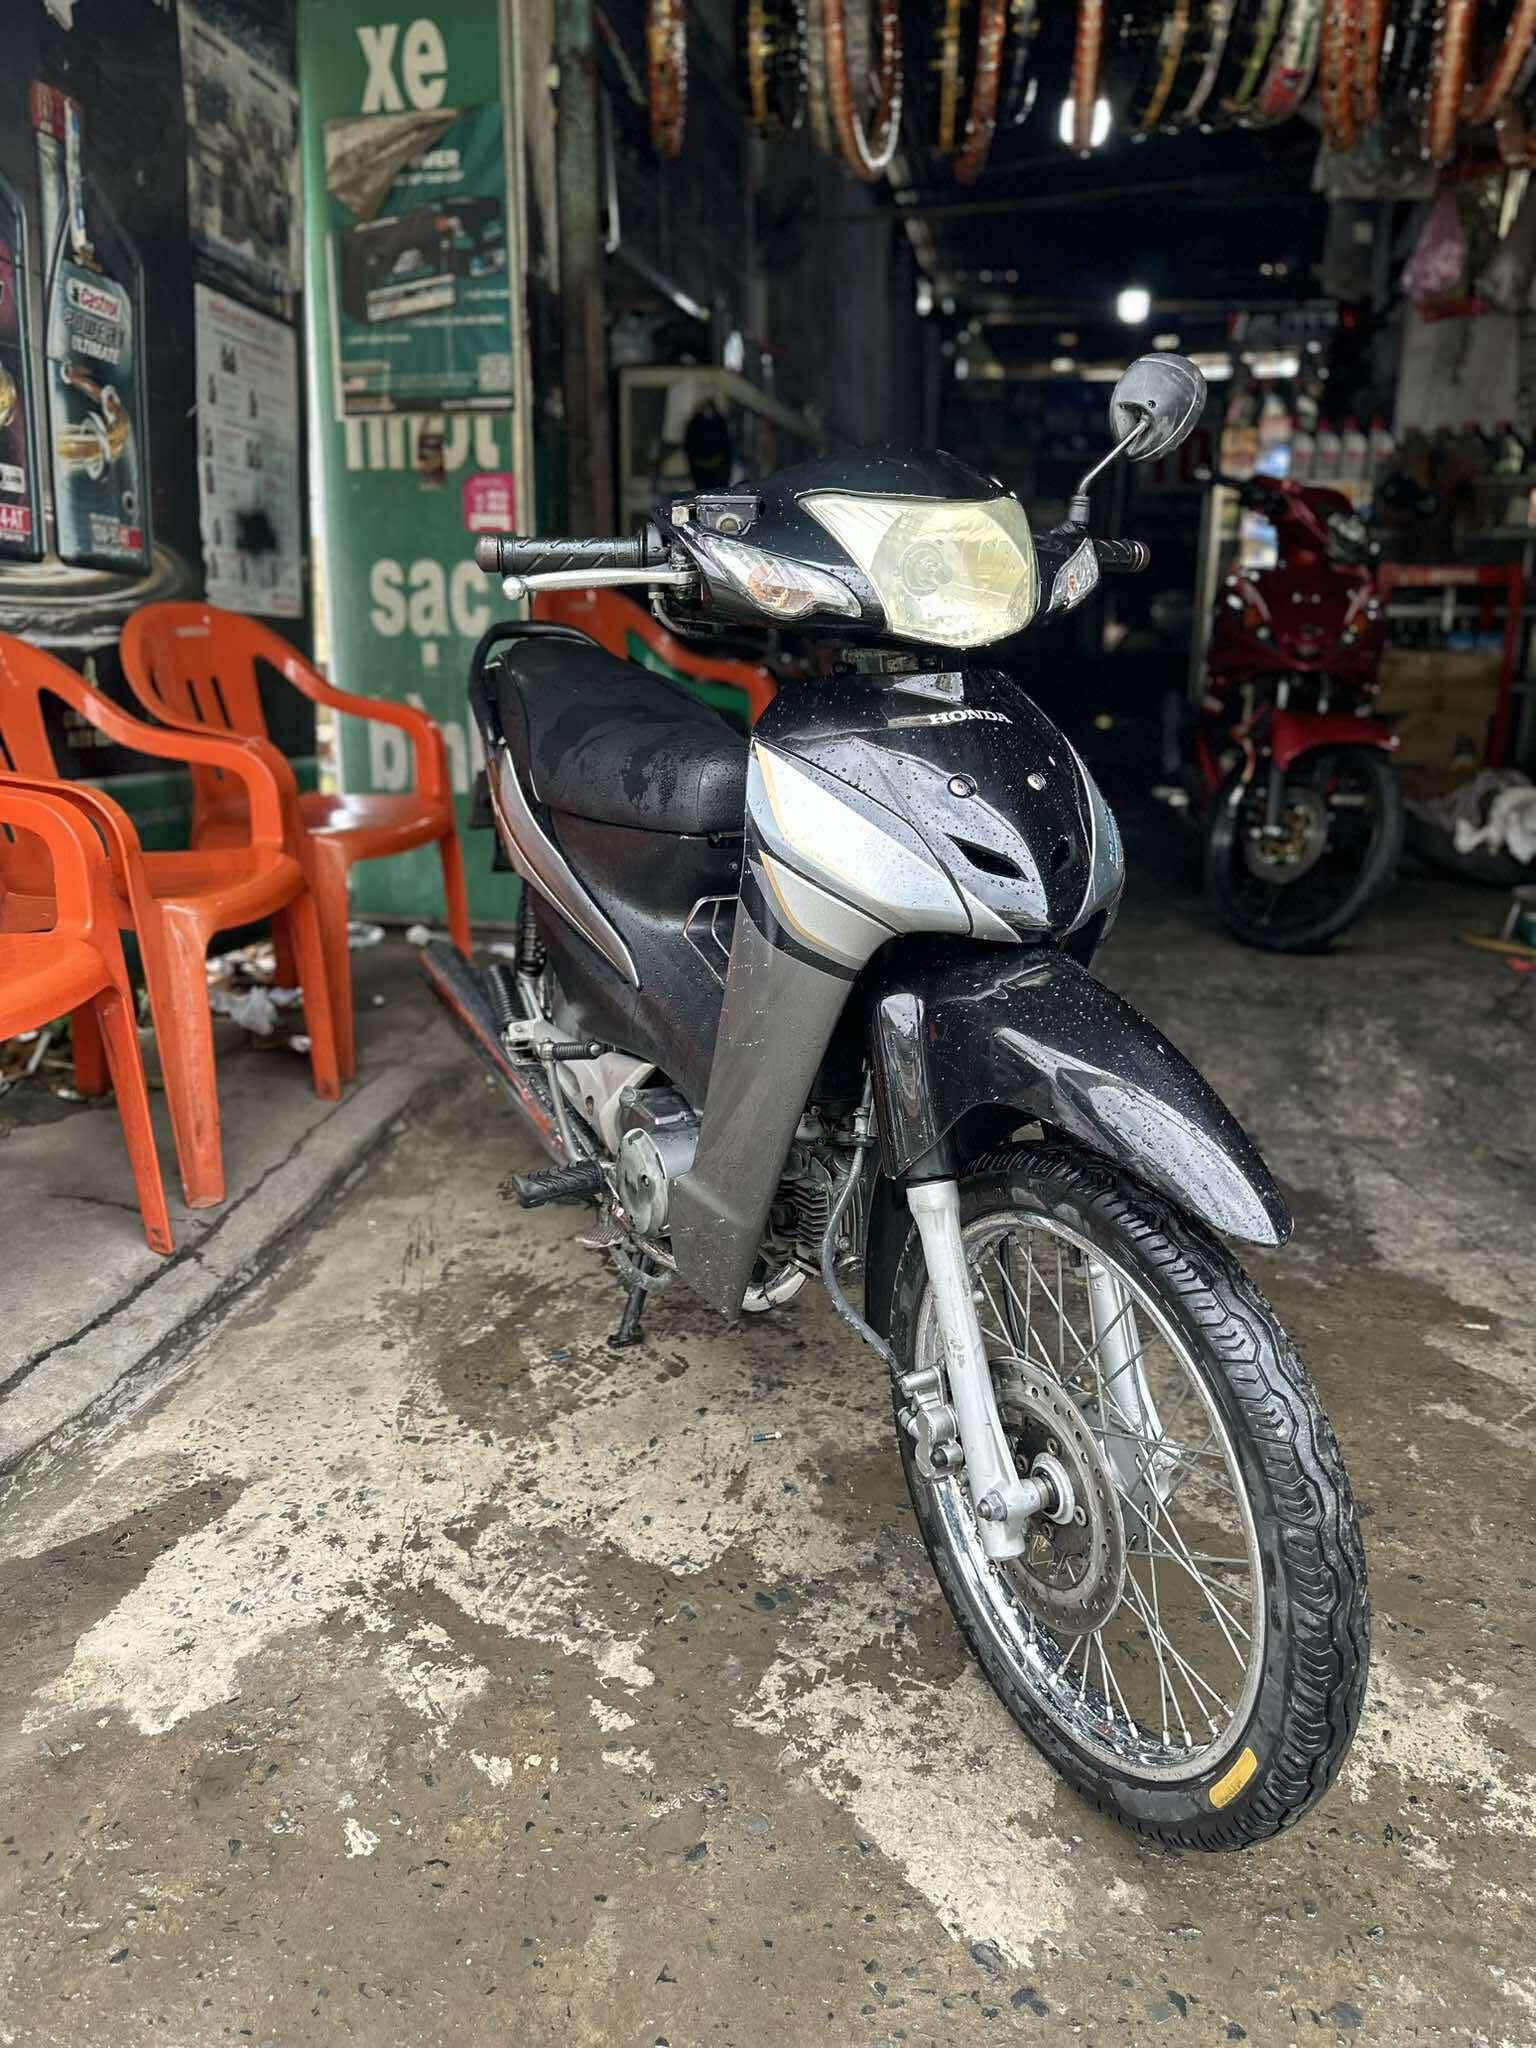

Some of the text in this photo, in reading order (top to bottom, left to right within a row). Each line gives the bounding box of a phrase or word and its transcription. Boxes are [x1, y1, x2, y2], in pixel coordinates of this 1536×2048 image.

[355, 18, 448, 113] xe
[80, 286, 119, 318] Castrol
[71, 334, 120, 365] ULTIMATE
[370, 558, 490, 668] sạc
[929, 709, 1014, 725] HONDA
